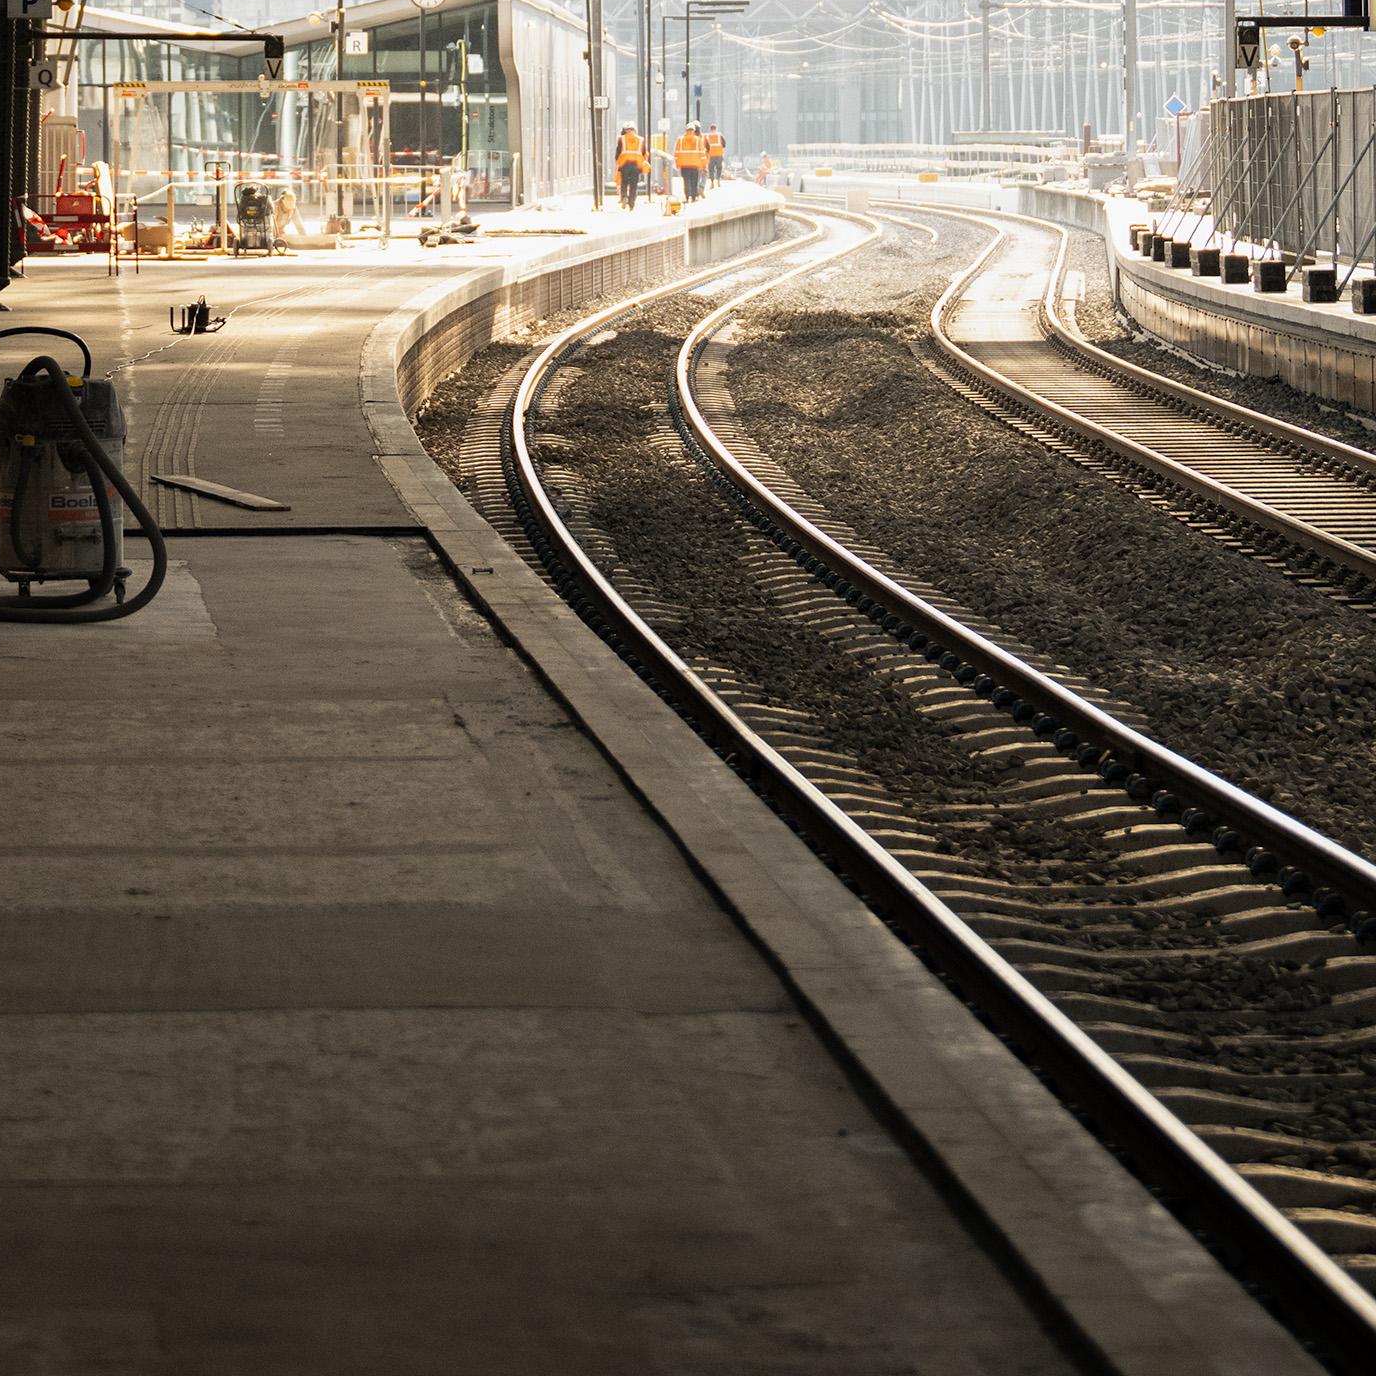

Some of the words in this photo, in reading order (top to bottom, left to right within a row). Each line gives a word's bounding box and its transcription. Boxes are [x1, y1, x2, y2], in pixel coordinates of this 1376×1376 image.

[352, 40, 361, 52] R
[1240, 45, 1258, 67] V
[37, 69, 53, 87] Q
[266, 59, 282, 79] V
[487, 105, 495, 143] Strukton
